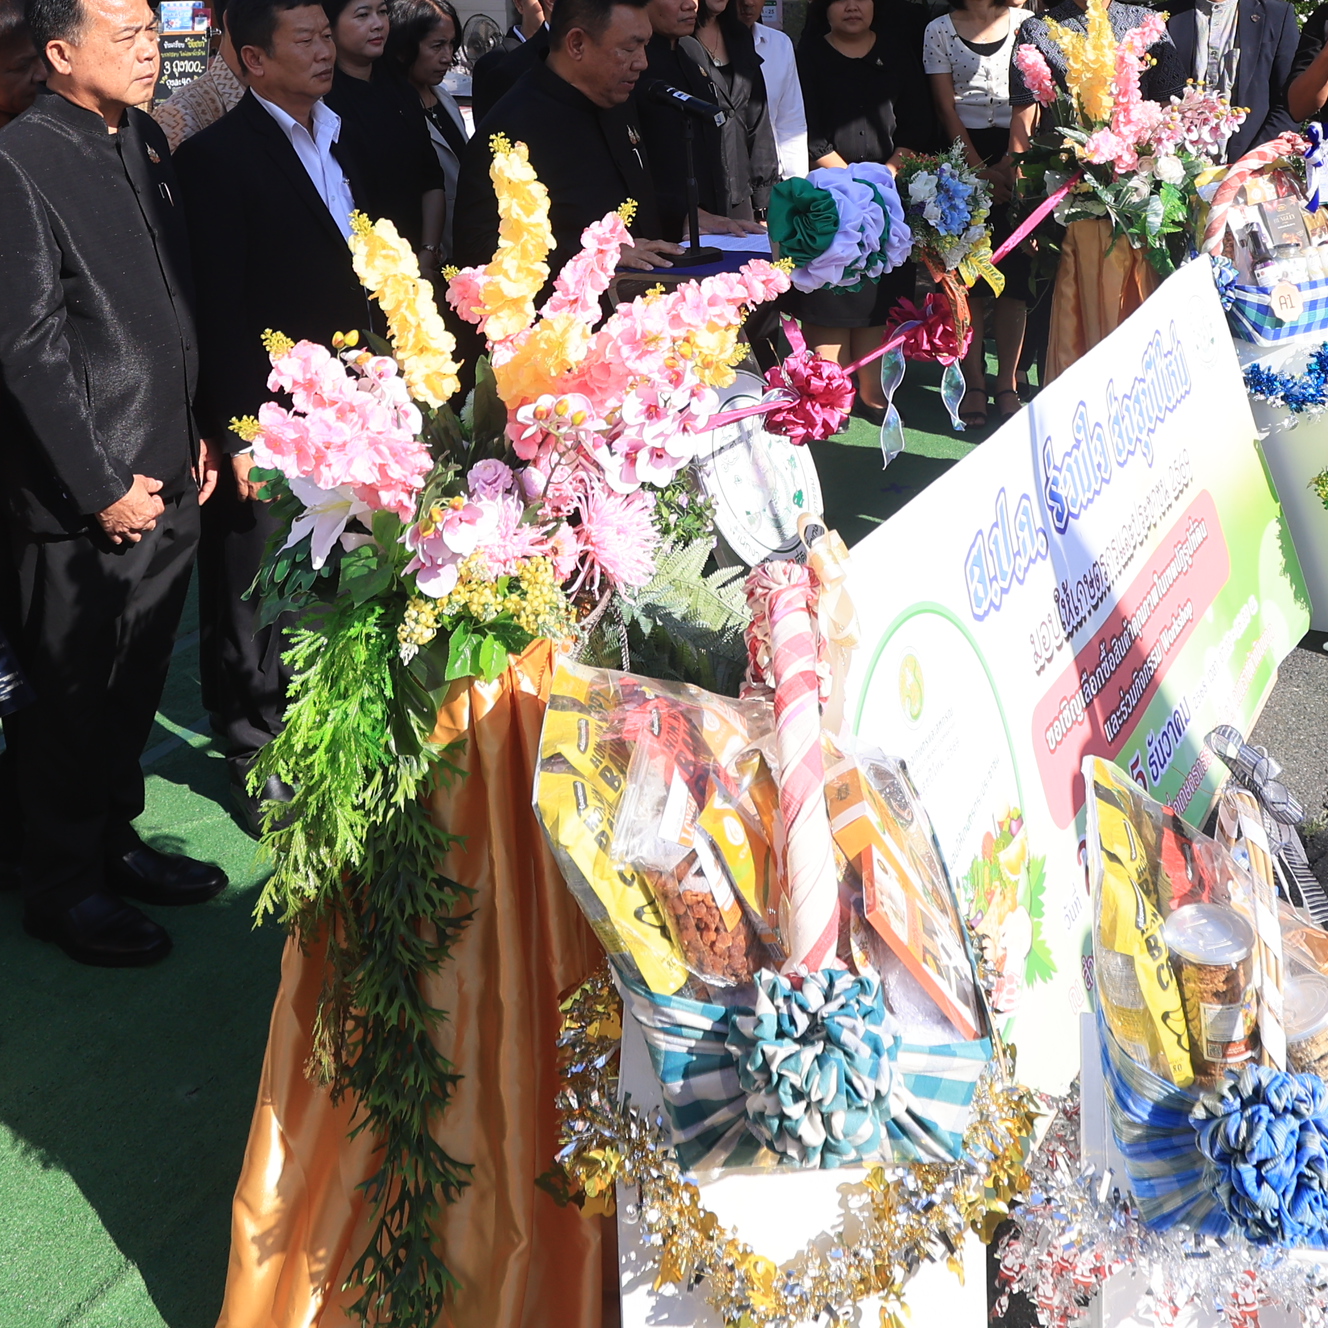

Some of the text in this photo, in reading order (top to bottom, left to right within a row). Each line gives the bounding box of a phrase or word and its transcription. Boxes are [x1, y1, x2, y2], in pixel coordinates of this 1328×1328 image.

[163, 61, 171, 74] 3
[1043, 400, 1112, 535] ร่วมใจ
[1106, 319, 1192, 468] ส่งสุขปีใหม่
[1030, 448, 1193, 675] มอบให้เกษตรกรและประชาชน 2569
[1045, 517, 1208, 753] ขอเชิญเลือกซื้อสินค้าคุณภาพในเขตปฏิรูปที่ดิน
[1104, 599, 1193, 745] และร่วมกิจกรรม Workshop
[1063, 881, 1082, 931] วันที่
[1146, 694, 1191, 784] ธันวาคม
[1066, 977, 1086, 1017] ณ
